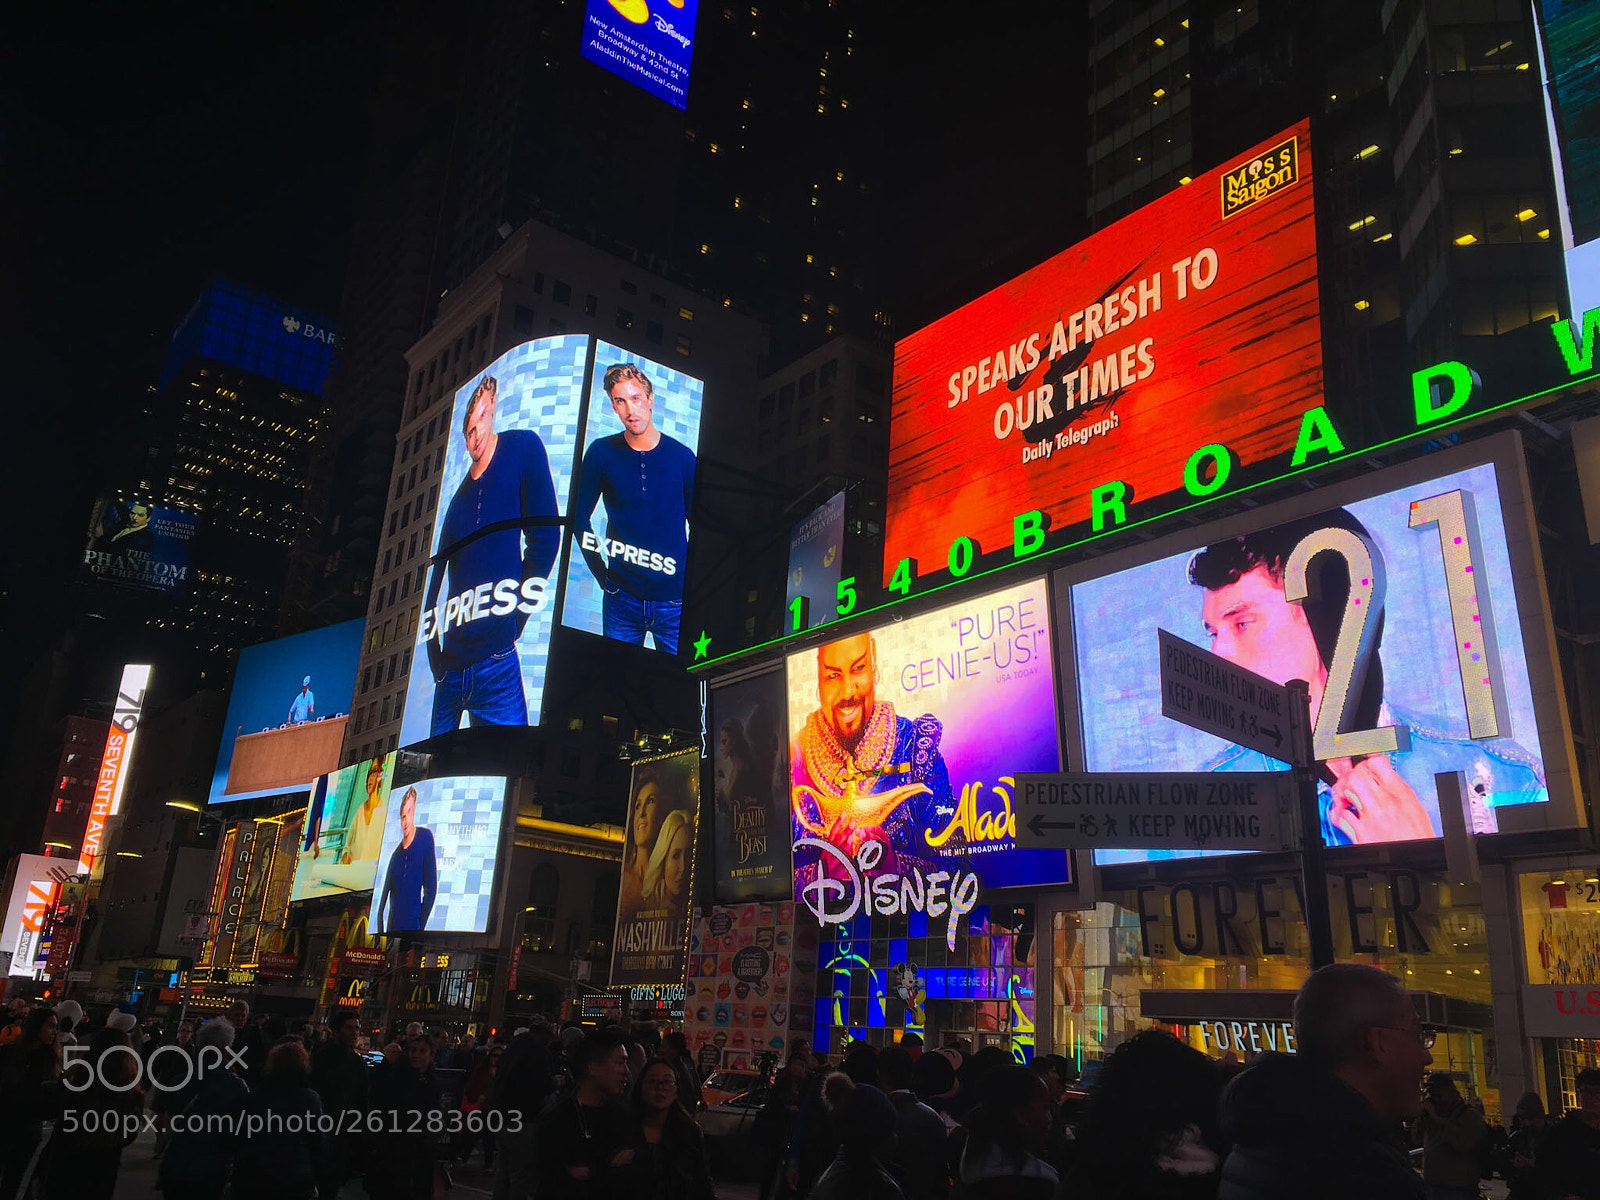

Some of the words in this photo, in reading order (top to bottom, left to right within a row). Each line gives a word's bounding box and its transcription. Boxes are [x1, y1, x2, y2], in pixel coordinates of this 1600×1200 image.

[589, 14, 609, 30] New
[610, 27, 656, 58] Amsterdam
[598, 30, 639, 58] Broadway
[640, 53, 647, 62] &
[648, 59, 669, 74] 42nd
[670, 70, 679, 80] St
[589, 39, 684, 96] AladdinTheMusical.com
[1227, 165, 1293, 211] Saigon
[947, 332, 1041, 408] SPEAKS
[1048, 272, 1162, 361] AFRESH
[1172, 247, 1219, 300] TO
[994, 383, 1054, 439] OUR
[1063, 337, 1155, 411] TIMES
[1022, 439, 1053, 464] Daily
[1056, 411, 1119, 450] Telegraph
[84, 549, 188, 581] PHANTOM
[91, 564, 109, 576] OF
[136, 572, 175, 587] OPERA
[581, 531, 677, 576] EXPRESS
[418, 576, 551, 646] EXPRESS
[996, 673, 1012, 684] USA
[1014, 667, 1039, 680] TODAY
[1166, 644, 1229, 692] PEDESTRIAN
[1230, 673, 1256, 702] FLOW
[1258, 685, 1282, 716] ZONE
[113, 689, 144, 734] 719
[1168, 681, 1192, 711] KEEP
[1198, 695, 1236, 728] MOVING
[95, 733, 124, 816] SEVENTH
[1025, 783, 1139, 805] PEDESTRIAN
[1149, 783, 1199, 805] FLOW
[1206, 783, 1258, 805] ZONE
[84, 819, 104, 857] AVE
[729, 800, 769, 833] BEAUTY
[1129, 815, 1176, 838] KEEP
[1184, 815, 1260, 838] MOVING
[735, 830, 769, 864] BEAST
[940, 849, 952, 857] THE
[968, 845, 1008, 855] BROADWAY
[225, 831, 253, 935] PALACE
[345, 950, 386, 962] McDonald's
[617, 919, 684, 953] NASHVILLE
[630, 987, 655, 1001] GIFTS
[661, 986, 686, 1001] LUGG
